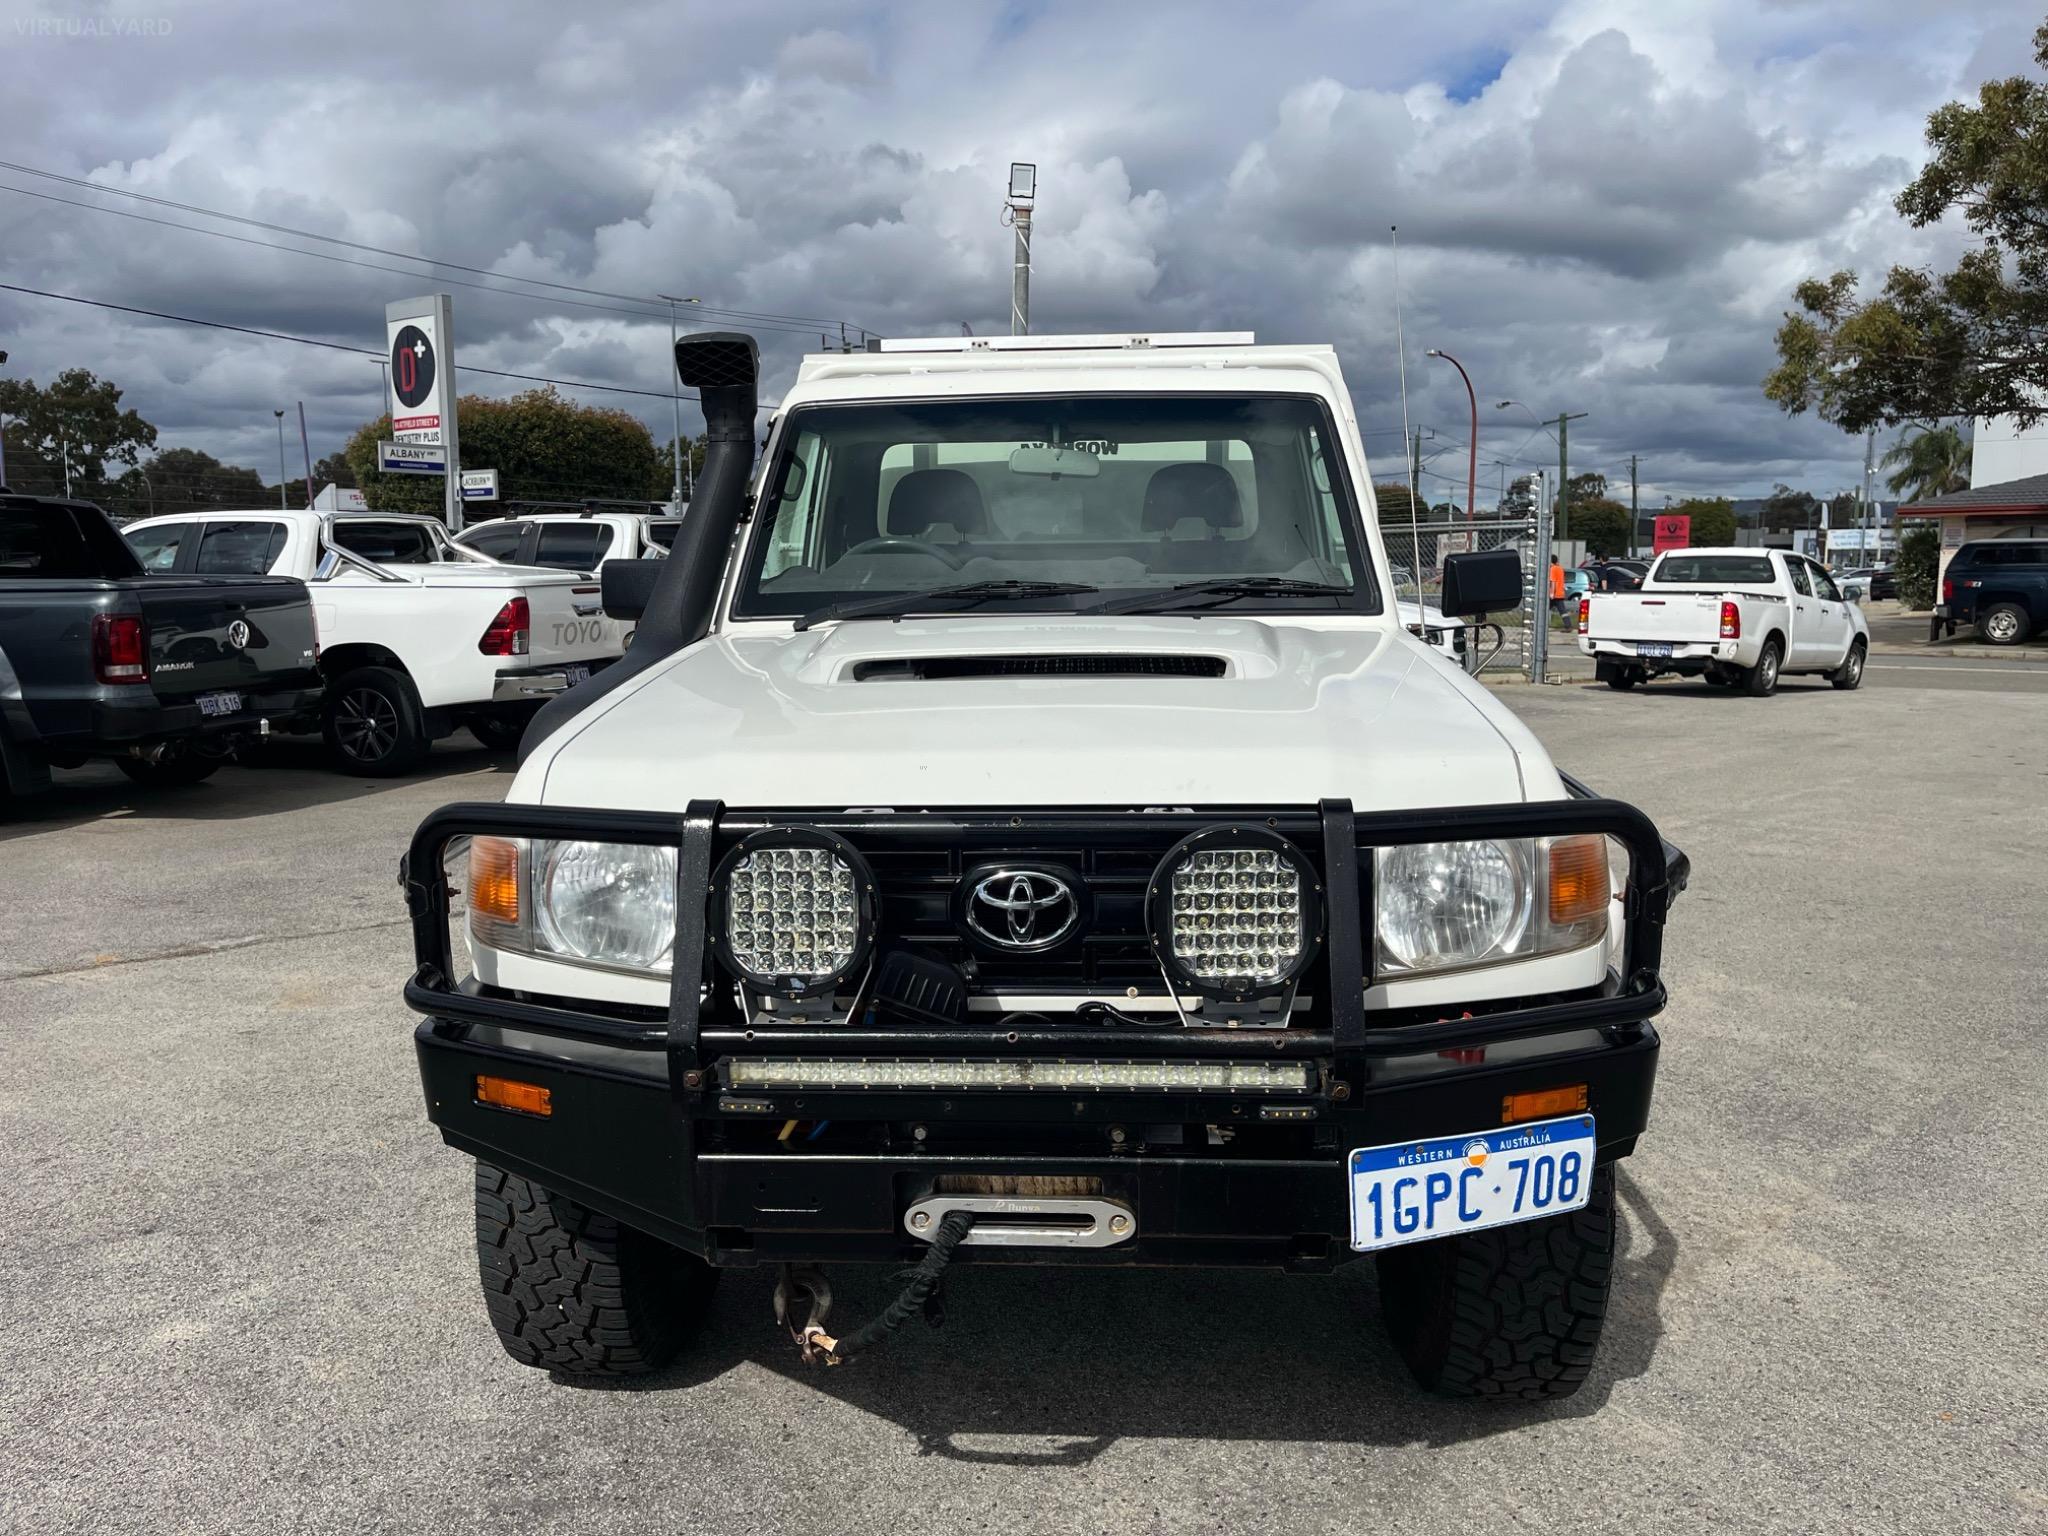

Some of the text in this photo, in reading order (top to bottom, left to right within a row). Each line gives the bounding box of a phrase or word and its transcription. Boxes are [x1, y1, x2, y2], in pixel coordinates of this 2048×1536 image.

[416, 417, 433, 427] STREET
[423, 431, 440, 443] PLUS
[390, 448, 425, 459] ALBANY
[551, 620, 609, 646] TOYO
[304, 649, 313, 657] V6
[155, 662, 195, 673] AMAROK
[1398, 1133, 1551, 1166] WESTERN AUSTRALIA
[1367, 1151, 1582, 1239] 1GPC 708
